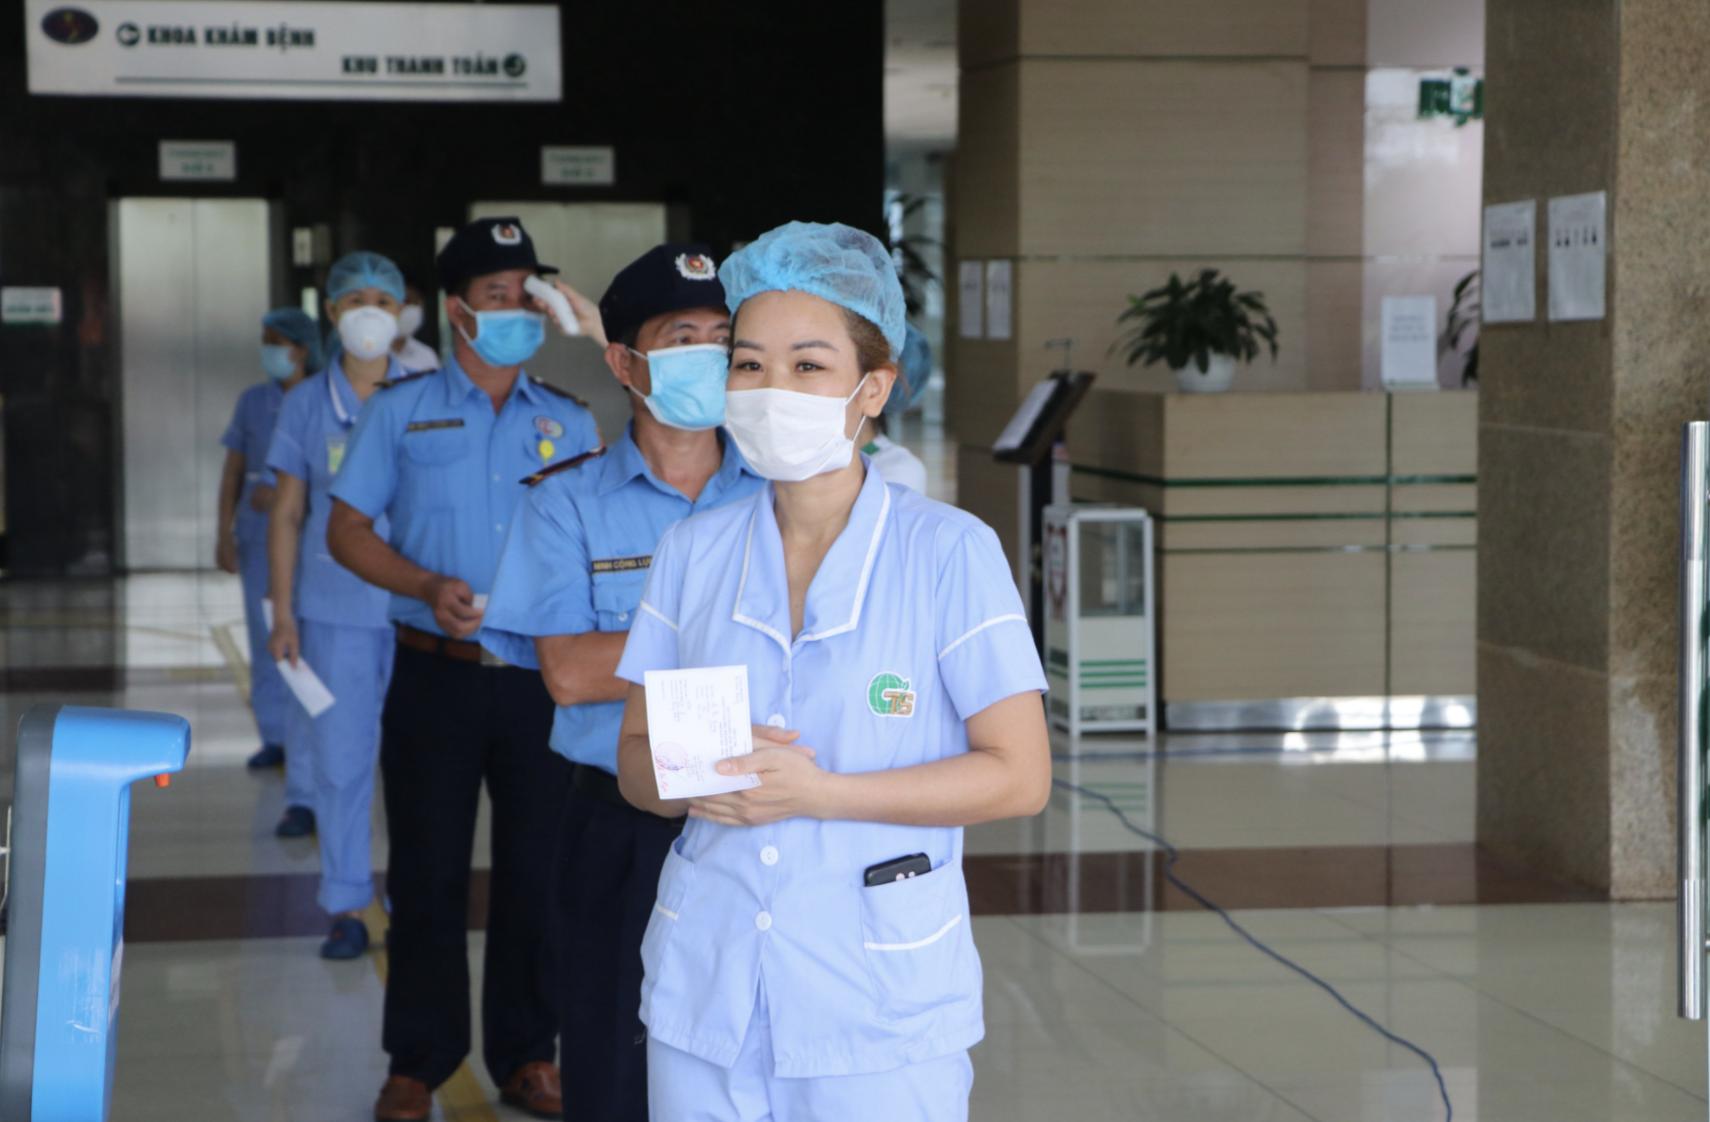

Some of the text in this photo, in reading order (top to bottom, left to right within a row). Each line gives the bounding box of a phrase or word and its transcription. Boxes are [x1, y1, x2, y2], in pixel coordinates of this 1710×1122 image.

[147, 26, 197, 45] KHOA
[204, 21, 258, 46] KHÁM
[342, 56, 377, 74] KHU
[386, 56, 444, 75] THANH
